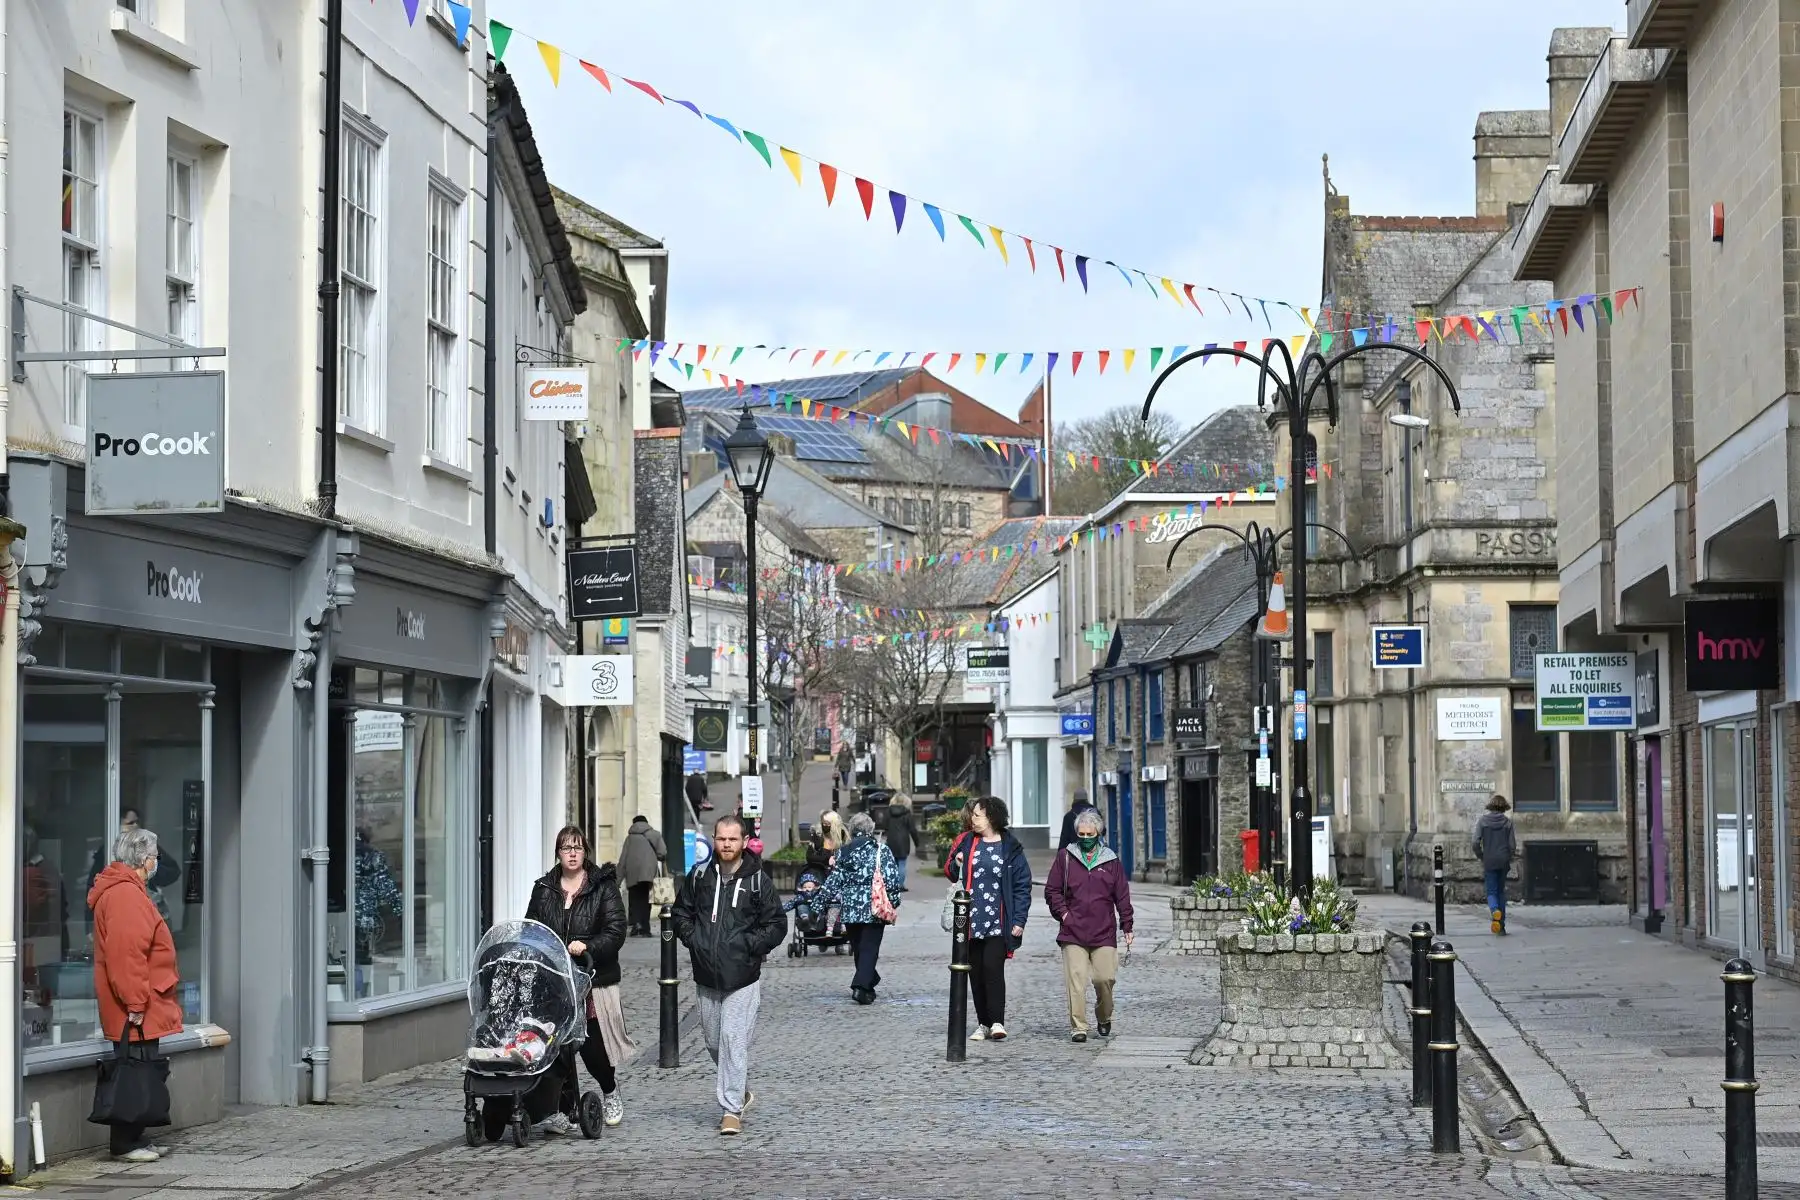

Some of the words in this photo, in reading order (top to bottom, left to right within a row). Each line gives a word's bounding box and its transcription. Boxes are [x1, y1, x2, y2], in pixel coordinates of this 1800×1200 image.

[1145, 512, 1203, 544] Boots
[147, 560, 202, 604] ProCook
[1698, 631, 1765, 660] hmv
[1543, 657, 1577, 668] RETAIL
[1579, 656, 1628, 667] PREMISES
[1570, 670, 1582, 681] TO
[1584, 670, 1601, 680] LET
[1550, 683, 1567, 694] ALL
[1569, 682, 1622, 695] ENQUIRIES
[1445, 711, 1494, 719] METHODIST
[1450, 720, 1488, 728] CHURCH
